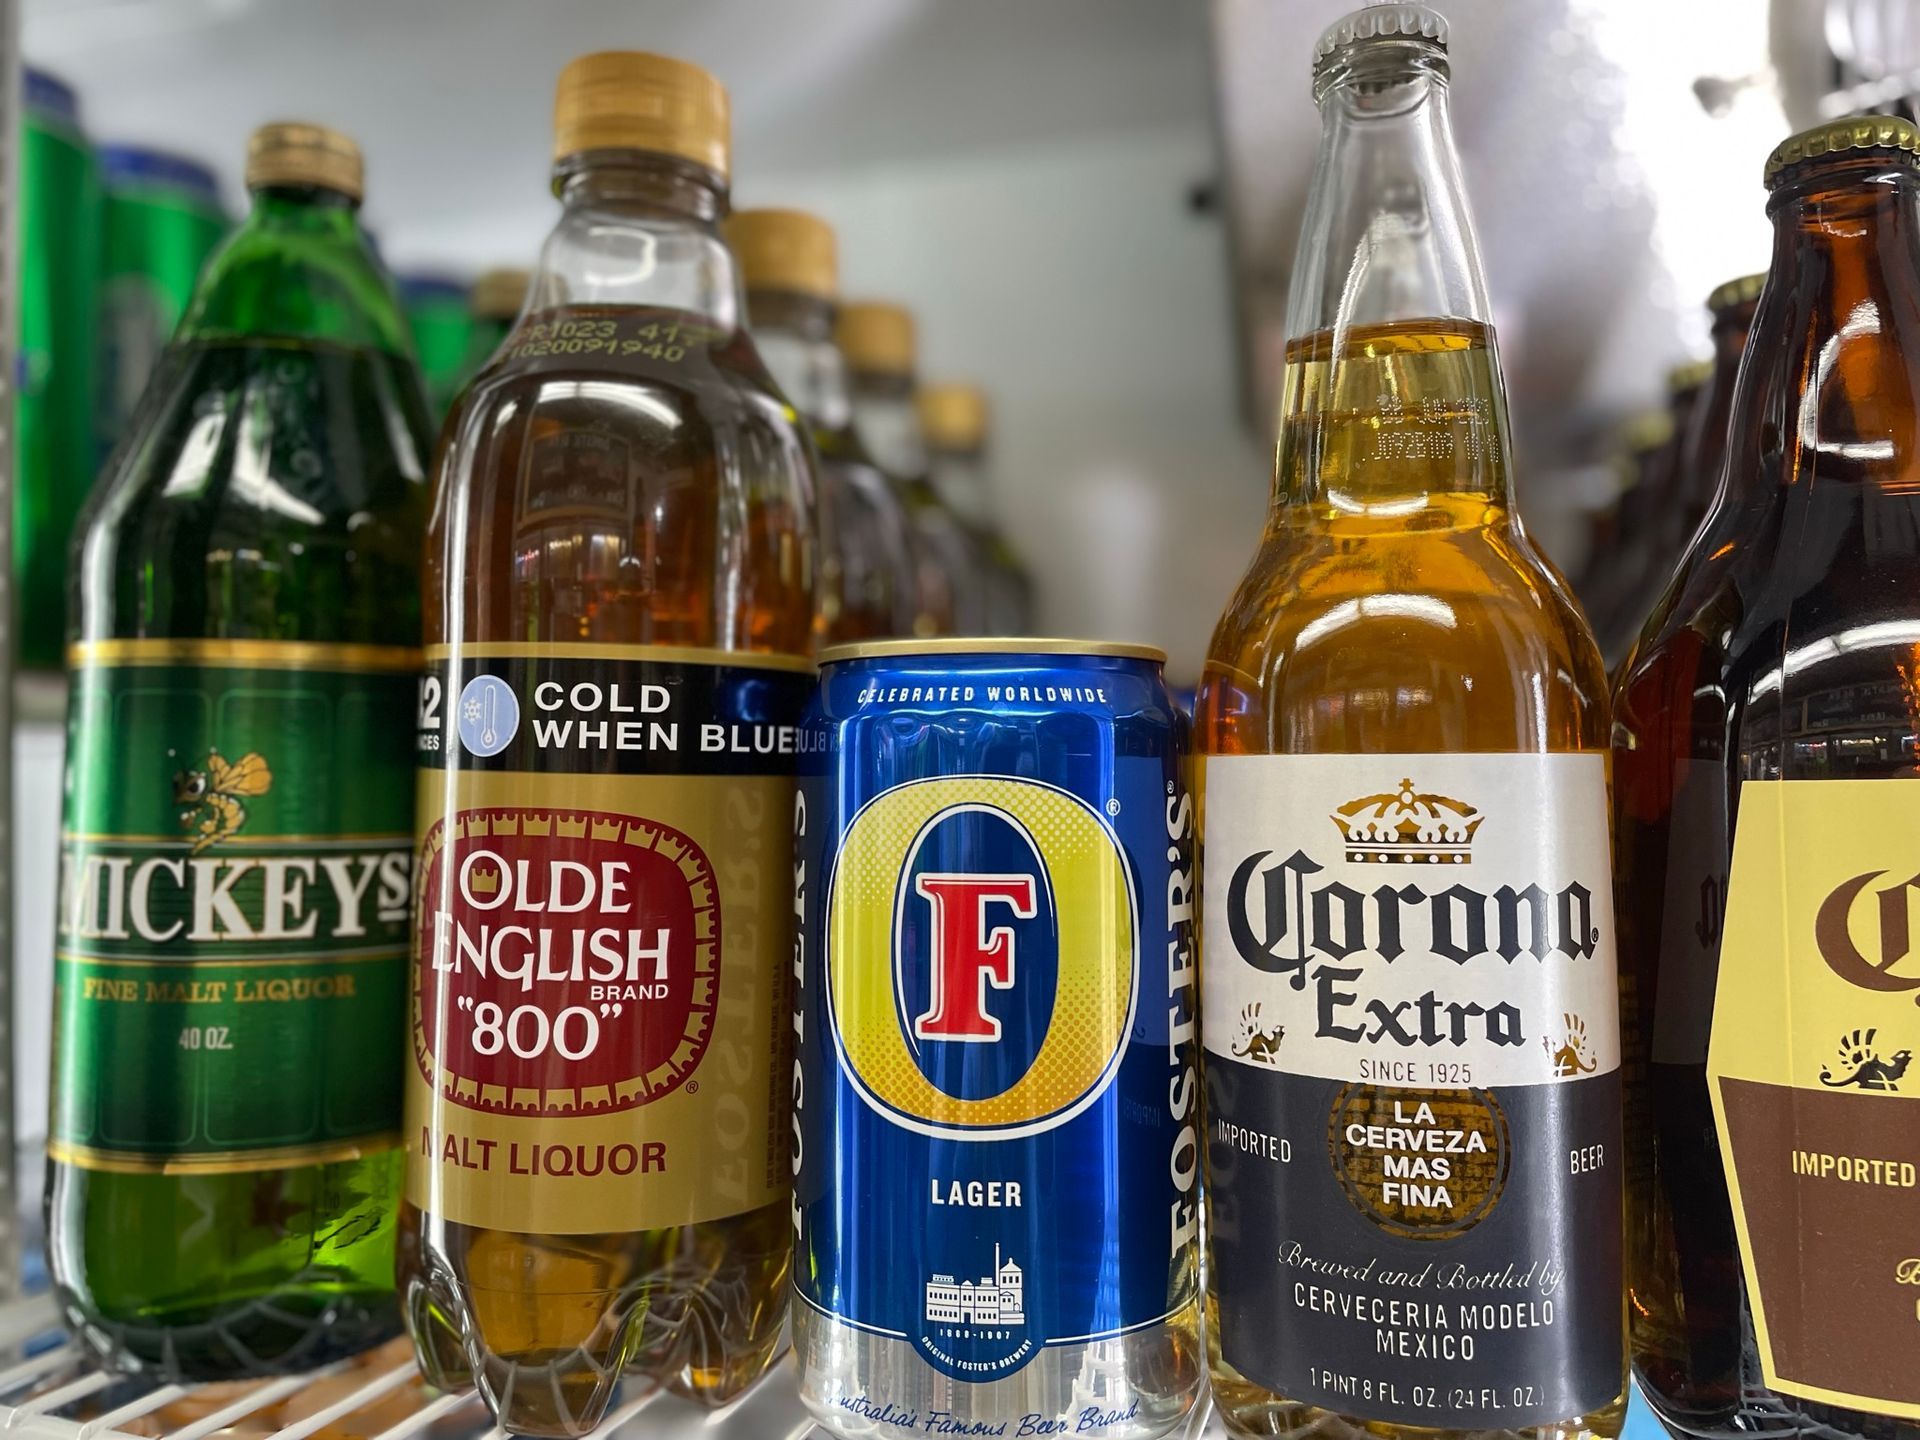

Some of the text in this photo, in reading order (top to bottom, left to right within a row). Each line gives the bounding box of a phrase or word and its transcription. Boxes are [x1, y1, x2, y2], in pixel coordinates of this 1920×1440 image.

[533, 681, 671, 713] COLD
[857, 686, 1107, 704] CELEBRATED WORLDWIDE
[532, 718, 679, 752] WHEN
[700, 725, 794, 754] BLUE
[459, 850, 632, 914] OLDE
[1227, 848, 1596, 991] Corona
[431, 910, 671, 993] ENGLISH
[84, 973, 357, 1003] FINE MALT LIQUOR
[590, 983, 669, 1001] BRAND
[1311, 965, 1527, 1047] Extra
[178, 1026, 234, 1050] 40 OZ.
[1359, 1057, 1472, 1084] SINCE 1925
[1394, 1101, 1436, 1125] LA
[422, 1126, 667, 1177] MALT LIQUOR
[1217, 1118, 1292, 1164] IMPORTED
[1345, 1123, 1487, 1154] CERVEZA
[1383, 1155, 1451, 1181] MAS
[1570, 1143, 1605, 1175] BEER
[1792, 1150, 1916, 1188] IMPORTED
[931, 1179, 1022, 1208] LAGER
[1382, 1182, 1454, 1208] FINA
[1278, 1240, 1567, 1296] Brewed and Bottled by
[1294, 1283, 1554, 1330] CERVECERIA MODELO
[921, 1336, 1032, 1372] ORIGINAL FOSTER'S BREWERY
[1376, 1328, 1474, 1361] MEXICO
[1310, 1367, 1317, 1387] 1
[1323, 1370, 1357, 1396] PINT
[1363, 1379, 1372, 1400] 8
[1379, 1382, 1405, 1405] FL.
[1413, 1386, 1442, 1408] OZ.
[1481, 1388, 1506, 1409] FL.
[829, 1396, 1140, 1438] ustralia's Famous Beer Brand
